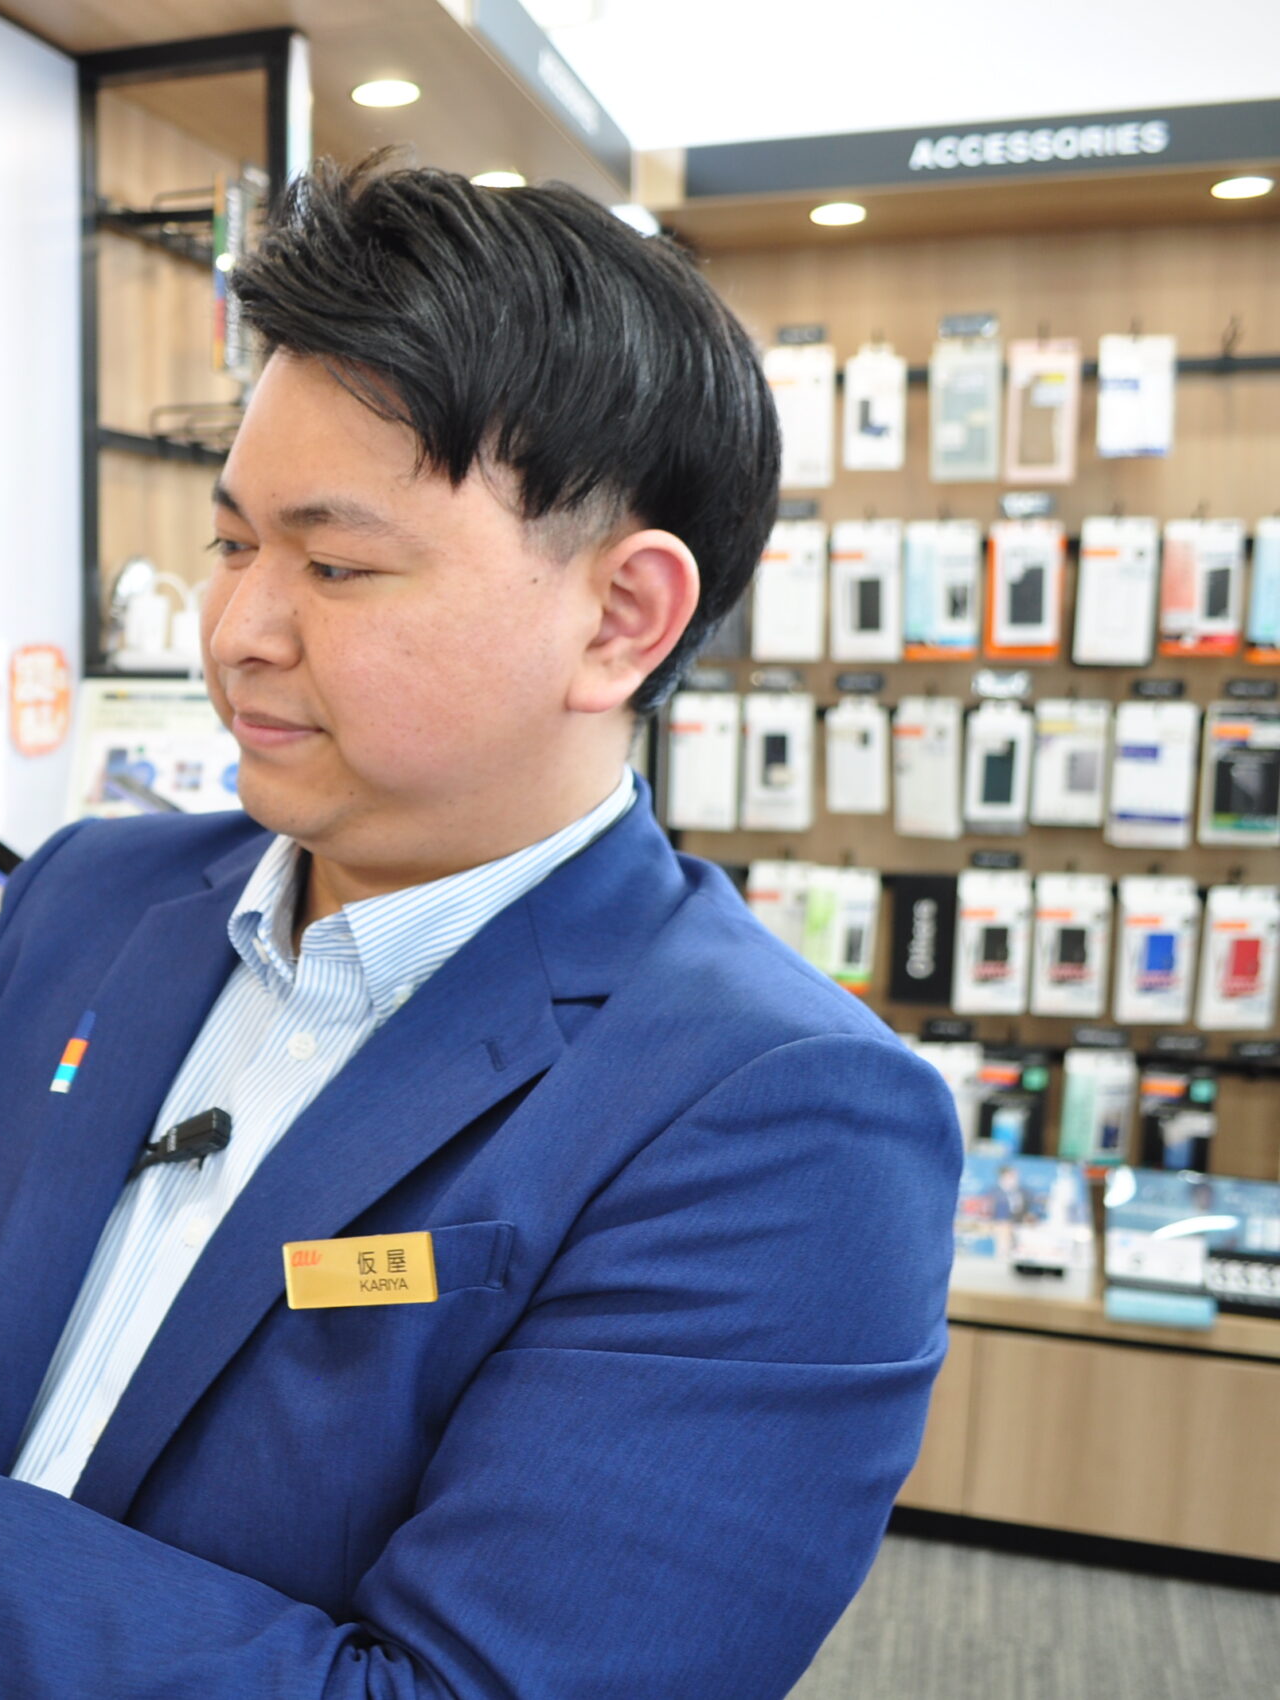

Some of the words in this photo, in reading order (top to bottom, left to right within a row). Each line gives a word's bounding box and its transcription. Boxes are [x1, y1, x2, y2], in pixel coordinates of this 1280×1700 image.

[910, 120, 1169, 171] ACCESSORIES
[291, 1250, 323, 1267] au
[359, 1277, 409, 1293] KARIYA
